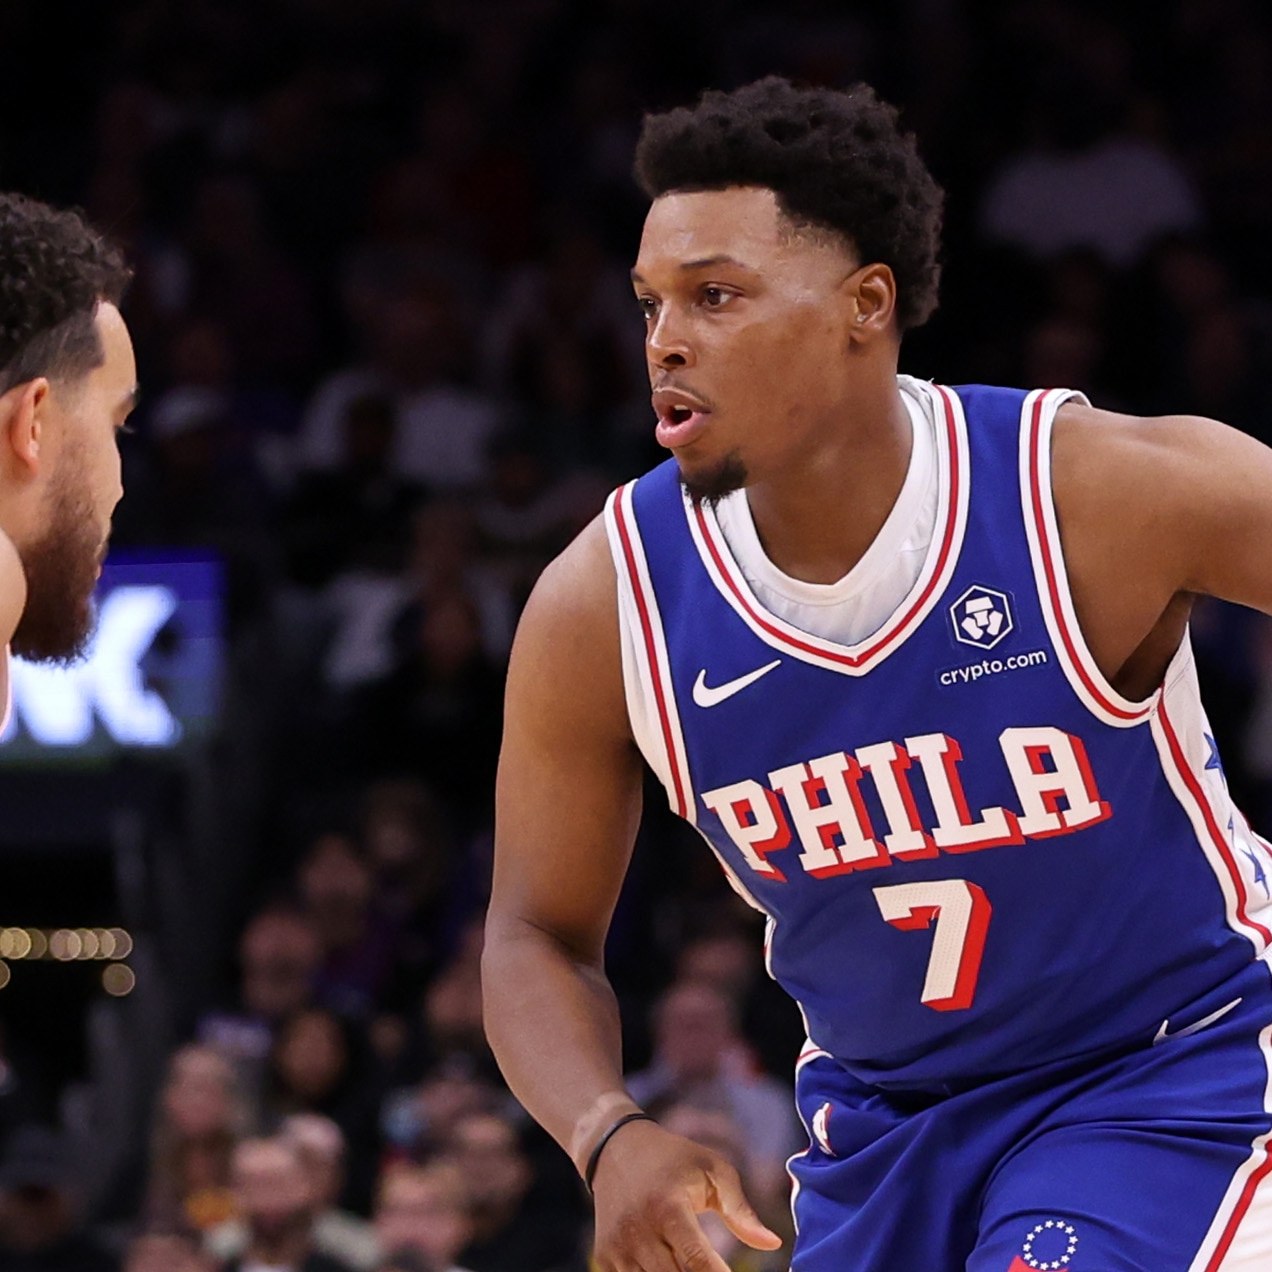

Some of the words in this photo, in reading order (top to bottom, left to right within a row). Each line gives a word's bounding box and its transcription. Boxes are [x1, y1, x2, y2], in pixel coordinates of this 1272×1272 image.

[940, 650, 1047, 686] crypto.com
[701, 727, 1112, 883] PHILA
[872, 879, 992, 1012] 7
